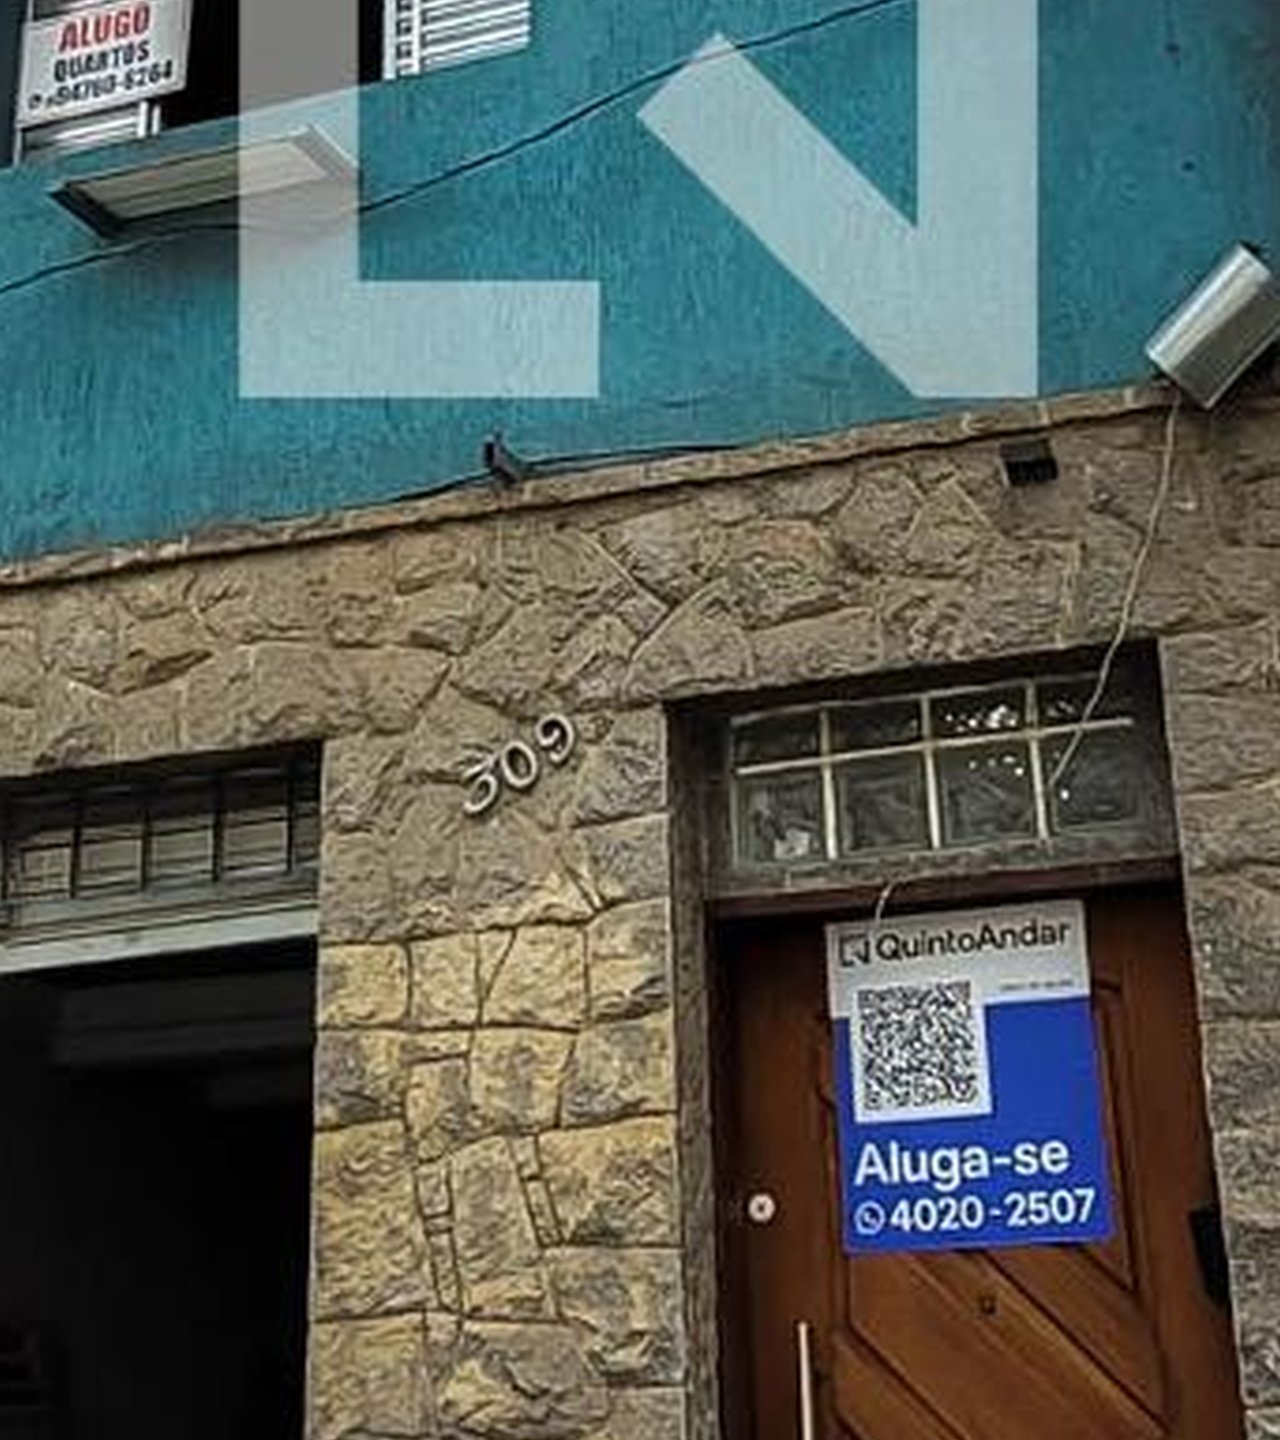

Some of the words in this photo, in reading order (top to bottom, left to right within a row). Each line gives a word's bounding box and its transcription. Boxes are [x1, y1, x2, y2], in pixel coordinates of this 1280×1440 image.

[58, 0, 150, 53] ALUGO
[53, 39, 150, 83] QUARTOS
[462, 712, 575, 814] 509
[875, 918, 1071, 962] QuintoAndar
[853, 1139, 1070, 1192] Aluga-se
